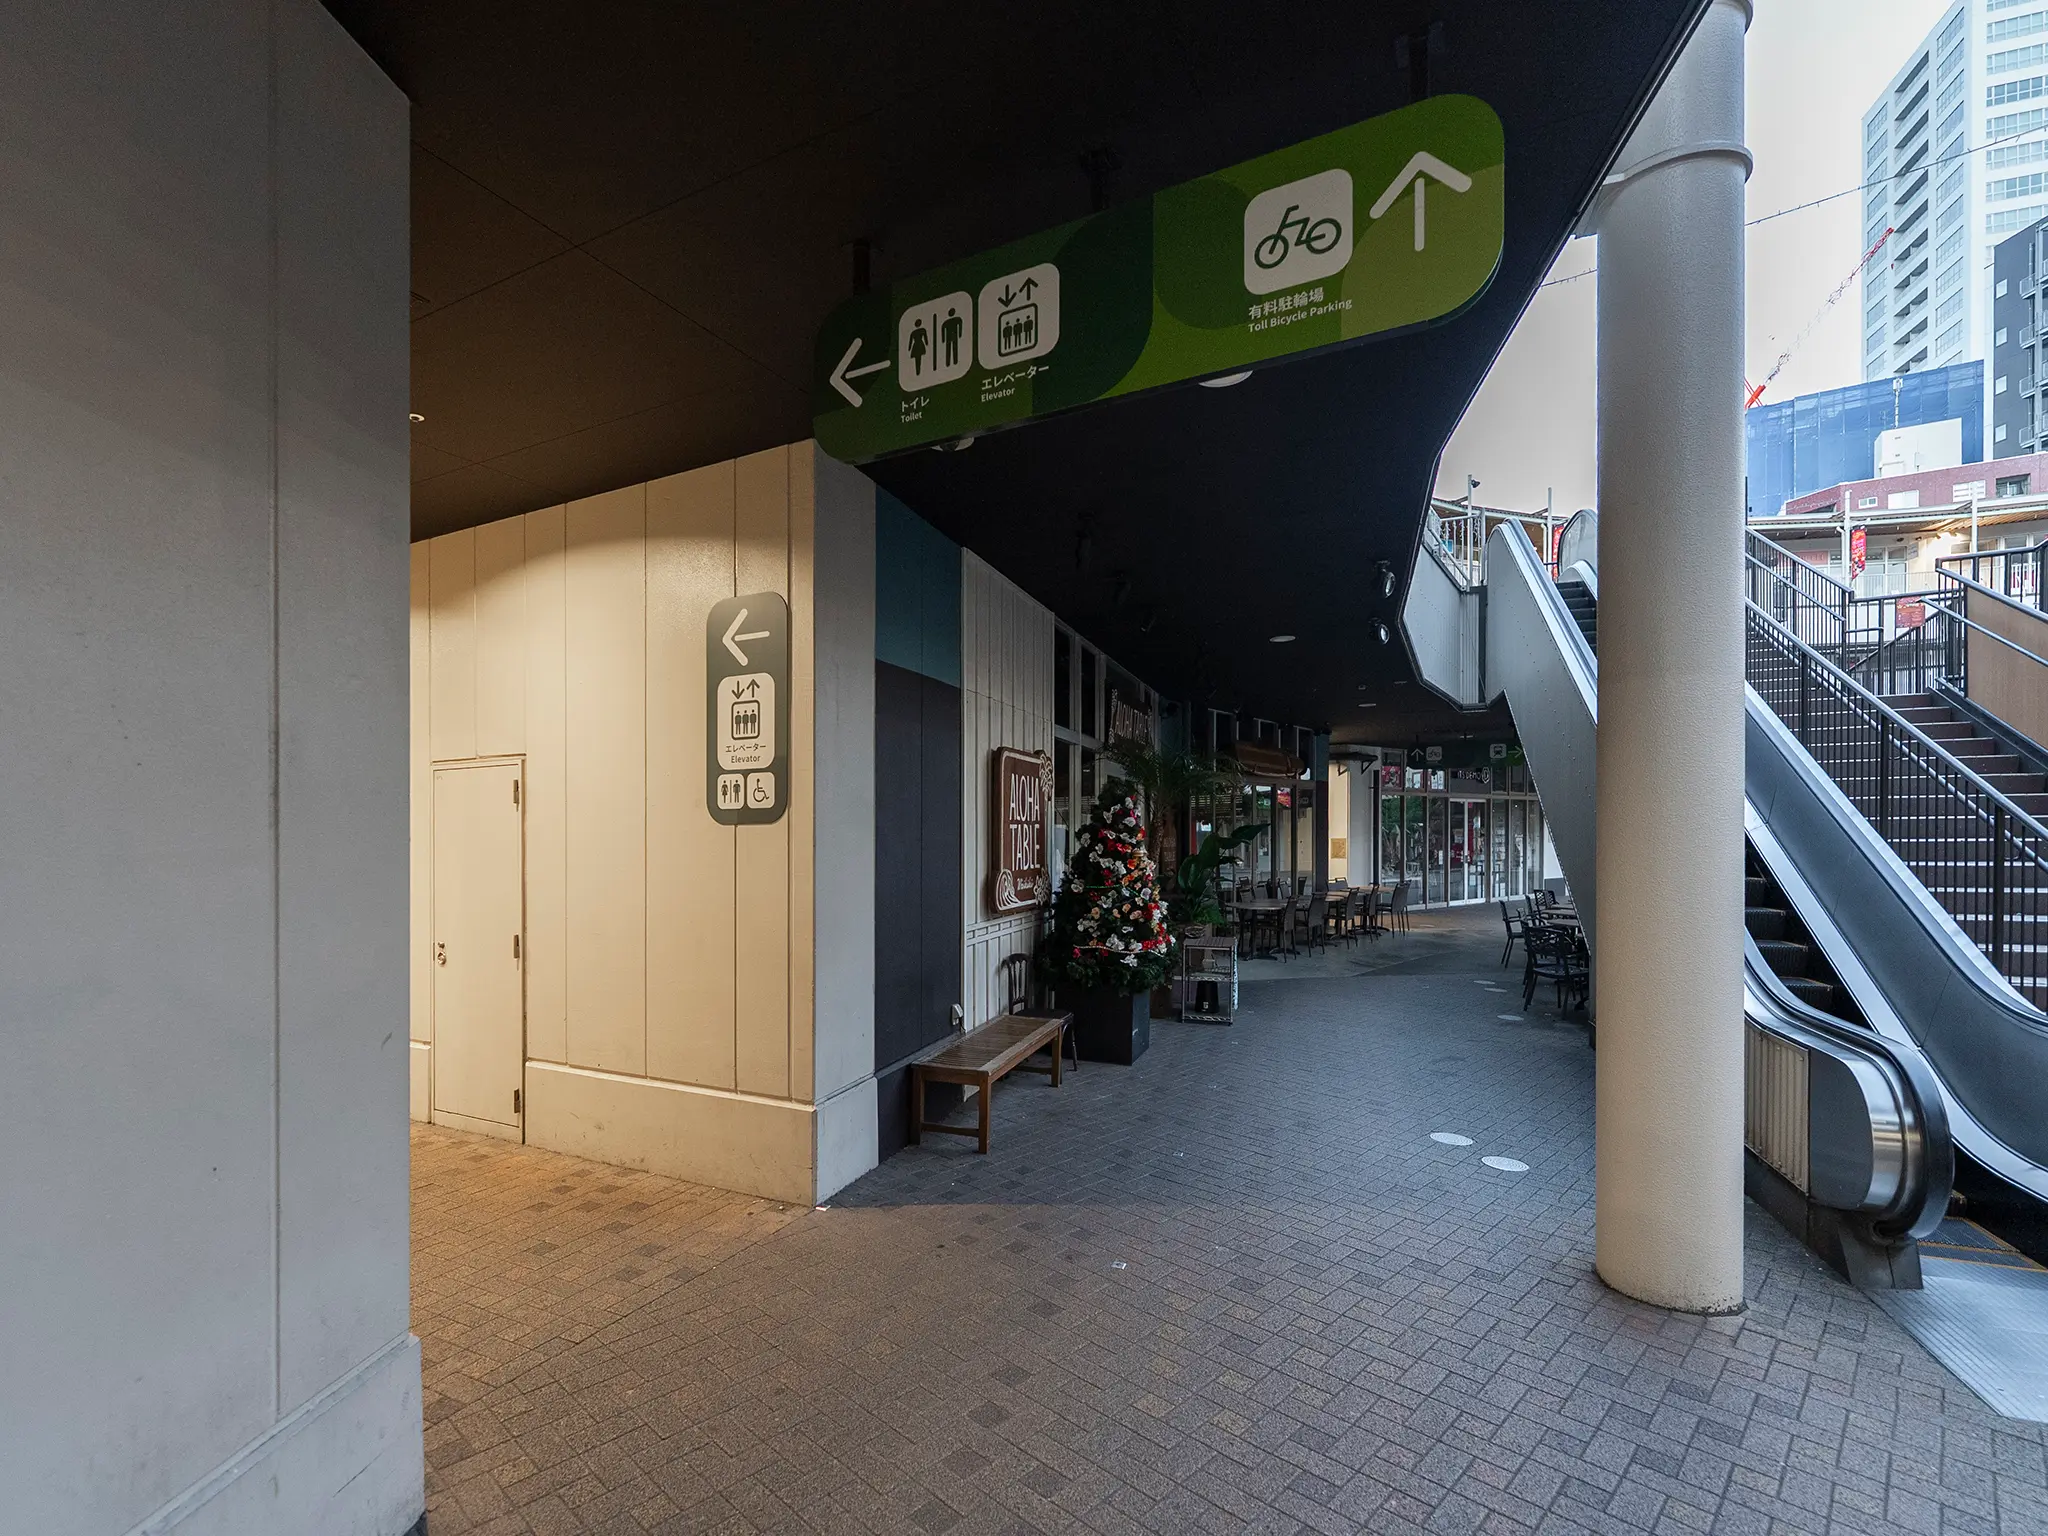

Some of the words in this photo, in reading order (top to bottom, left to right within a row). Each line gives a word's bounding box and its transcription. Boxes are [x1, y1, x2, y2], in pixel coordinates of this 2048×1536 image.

[1249, 287, 1324, 319] 有料駐輪場
[1248, 320, 1268, 333] Toll
[1270, 310, 1308, 329] Bicycle
[1310, 299, 1353, 318] Parking
[981, 366, 1049, 390] エレベーター
[901, 396, 930, 413] トイレ
[981, 387, 1015, 402] Elevator
[901, 412, 923, 423] Toilet
[725, 743, 766, 752] エレベーター
[731, 754, 761, 764] Elevator
[1009, 773, 1040, 822] ALOHA
[1009, 823, 1040, 871] TABLE
